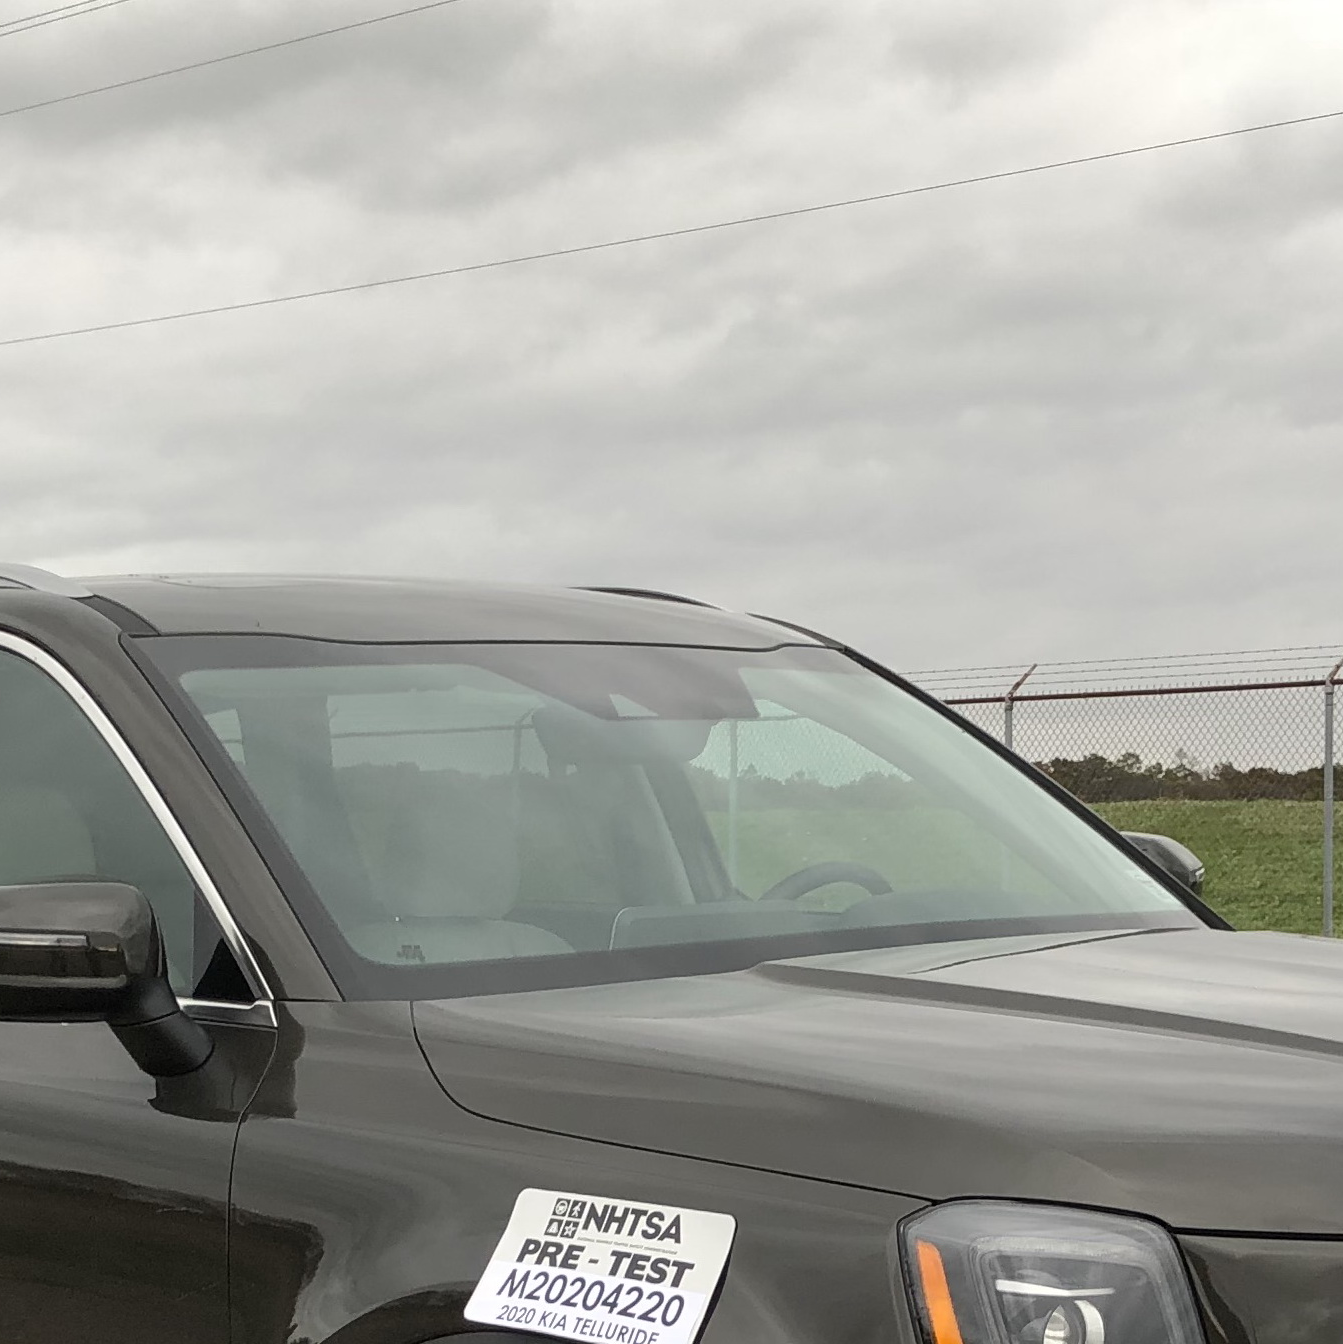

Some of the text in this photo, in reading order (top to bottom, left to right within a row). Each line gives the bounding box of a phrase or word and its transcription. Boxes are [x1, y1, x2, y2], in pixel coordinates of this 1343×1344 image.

[582, 1202, 682, 1244] NHTSA
[607, 1250, 695, 1288] TEST
[495, 1268, 685, 1327] M20204220
[495, 1305, 536, 1325] 2020
[537, 1311, 567, 1331] KIA
